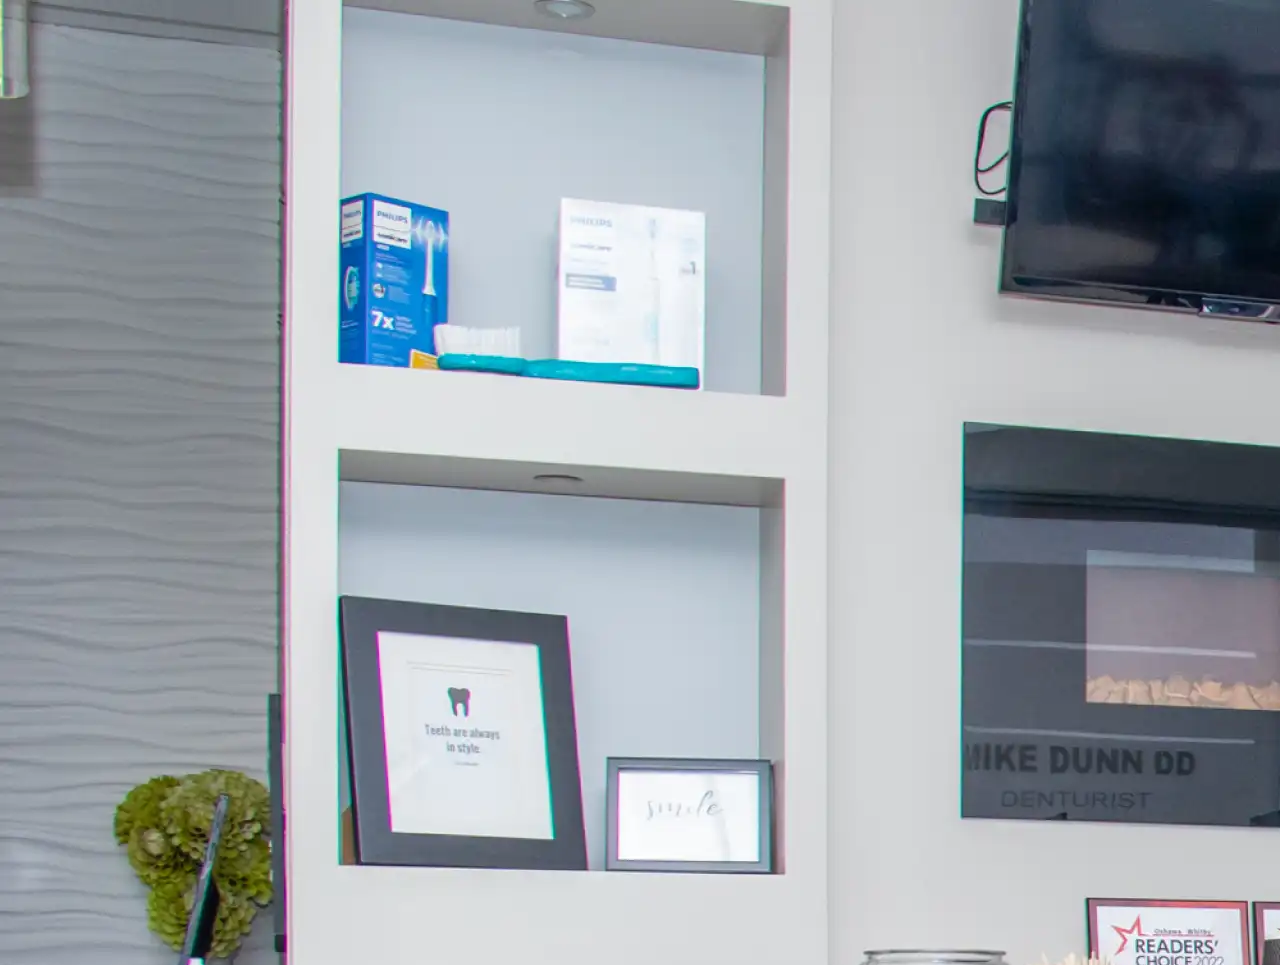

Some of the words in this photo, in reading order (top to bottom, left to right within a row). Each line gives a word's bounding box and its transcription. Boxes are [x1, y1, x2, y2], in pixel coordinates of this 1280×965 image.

[424, 723, 451, 737] Teeth
[453, 729, 468, 738] are
[469, 729, 500, 741] always
[446, 742, 455, 752] in
[1049, 746, 1143, 775] DUNN
[1153, 750, 1196, 776] DD
[1000, 790, 1153, 809] DENTURIST
